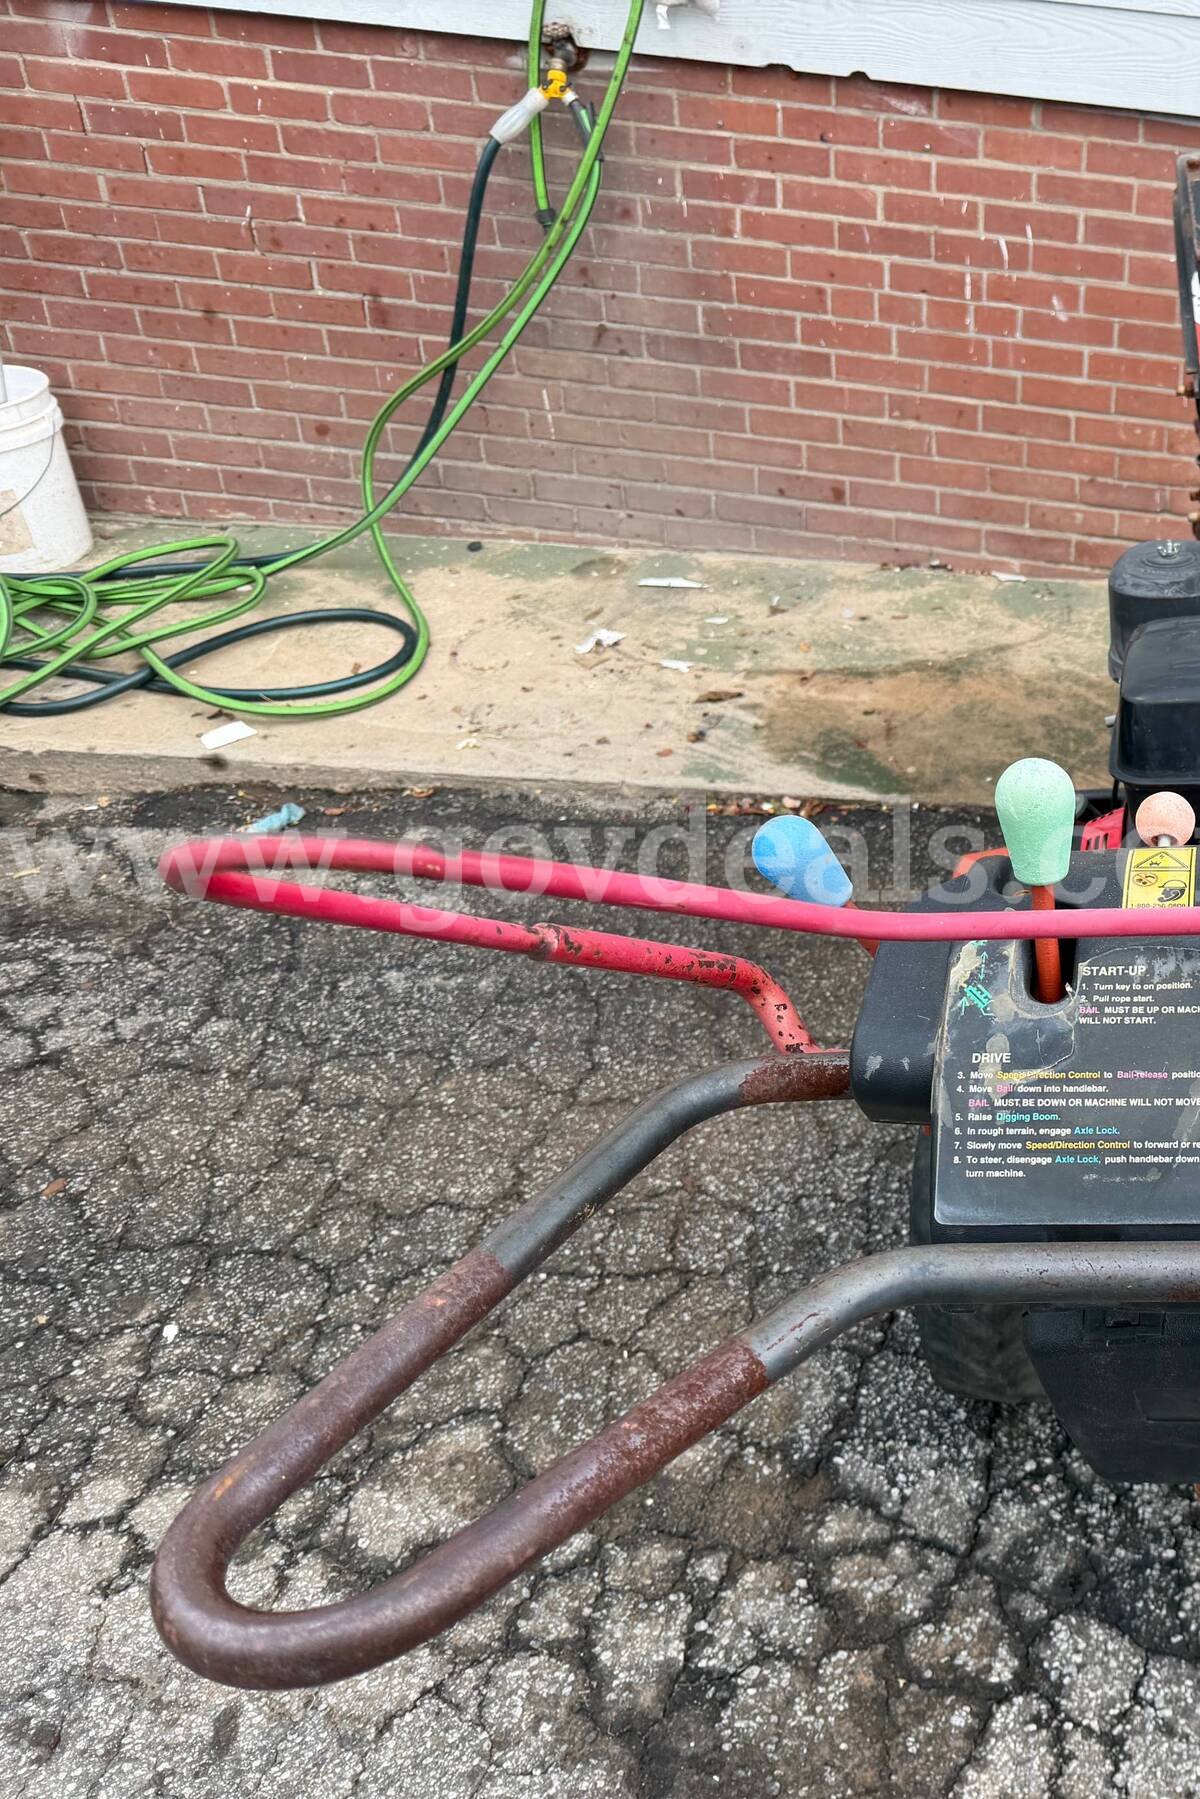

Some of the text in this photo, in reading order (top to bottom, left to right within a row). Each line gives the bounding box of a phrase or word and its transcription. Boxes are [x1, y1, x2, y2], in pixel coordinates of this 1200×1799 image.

[1082, 965, 1147, 977] START-UP
[1115, 983, 1131, 992] key
[1156, 981, 1193, 992] position.
[1111, 996, 1131, 1004] rope
[1079, 1006, 1100, 1014] BAIL
[1104, 1006, 1130, 1014] MUST
[1132, 1006, 1145, 1014] BE
[1124, 1016, 1156, 1024] START.
[971, 1052, 1011, 1064] DRIVE
[957, 1071, 966, 1080] 3.
[970, 1071, 993, 1080] Move
[1068, 1070, 1100, 1079] Control
[1103, 1071, 1113, 1079] to
[1117, 1070, 1168, 1079] Bail-release
[956, 1084, 1109, 1093] 4. Move Bail down into handlebar.
[968, 1098, 990, 1107] BAIL
[994, 1098, 1020, 1107] MUST
[1022, 1098, 1035, 1107] BE
[1037, 1098, 1066, 1107] DOWN
[1068, 1098, 1082, 1106] OR
[1084, 1097, 1127, 1106] MACHINE
[1129, 1097, 1151, 1106] WILL
[1153, 1097, 1174, 1106] NOT
[955, 1112, 1061, 1123] 5. Raise Digging Boom.
[954, 1126, 1120, 1138] 6. In rough terrain, engage Axle Lock.
[954, 1141, 962, 1150] 7.
[966, 1141, 996, 1152] Slowly
[1025, 1140, 1095, 1151] Speed/Direction
[1097, 1140, 1130, 1150] Control
[1133, 1141, 1142, 1149] to
[1144, 1140, 1179, 1149] forward
[953, 1156, 962, 1164] 8.
[966, 1156, 978, 1164] To
[980, 1156, 1005, 1166] steer,
[1007, 1155, 1052, 1166] disengage
[1055, 1155, 1075, 1164] Axle
[1077, 1155, 1101, 1165] Lock,
[1104, 1155, 1127, 1165] push
[1129, 1155, 1173, 1164] handlebar
[1175, 1155, 1199, 1163] down
[965, 1169, 1026, 1178] turn machine.
